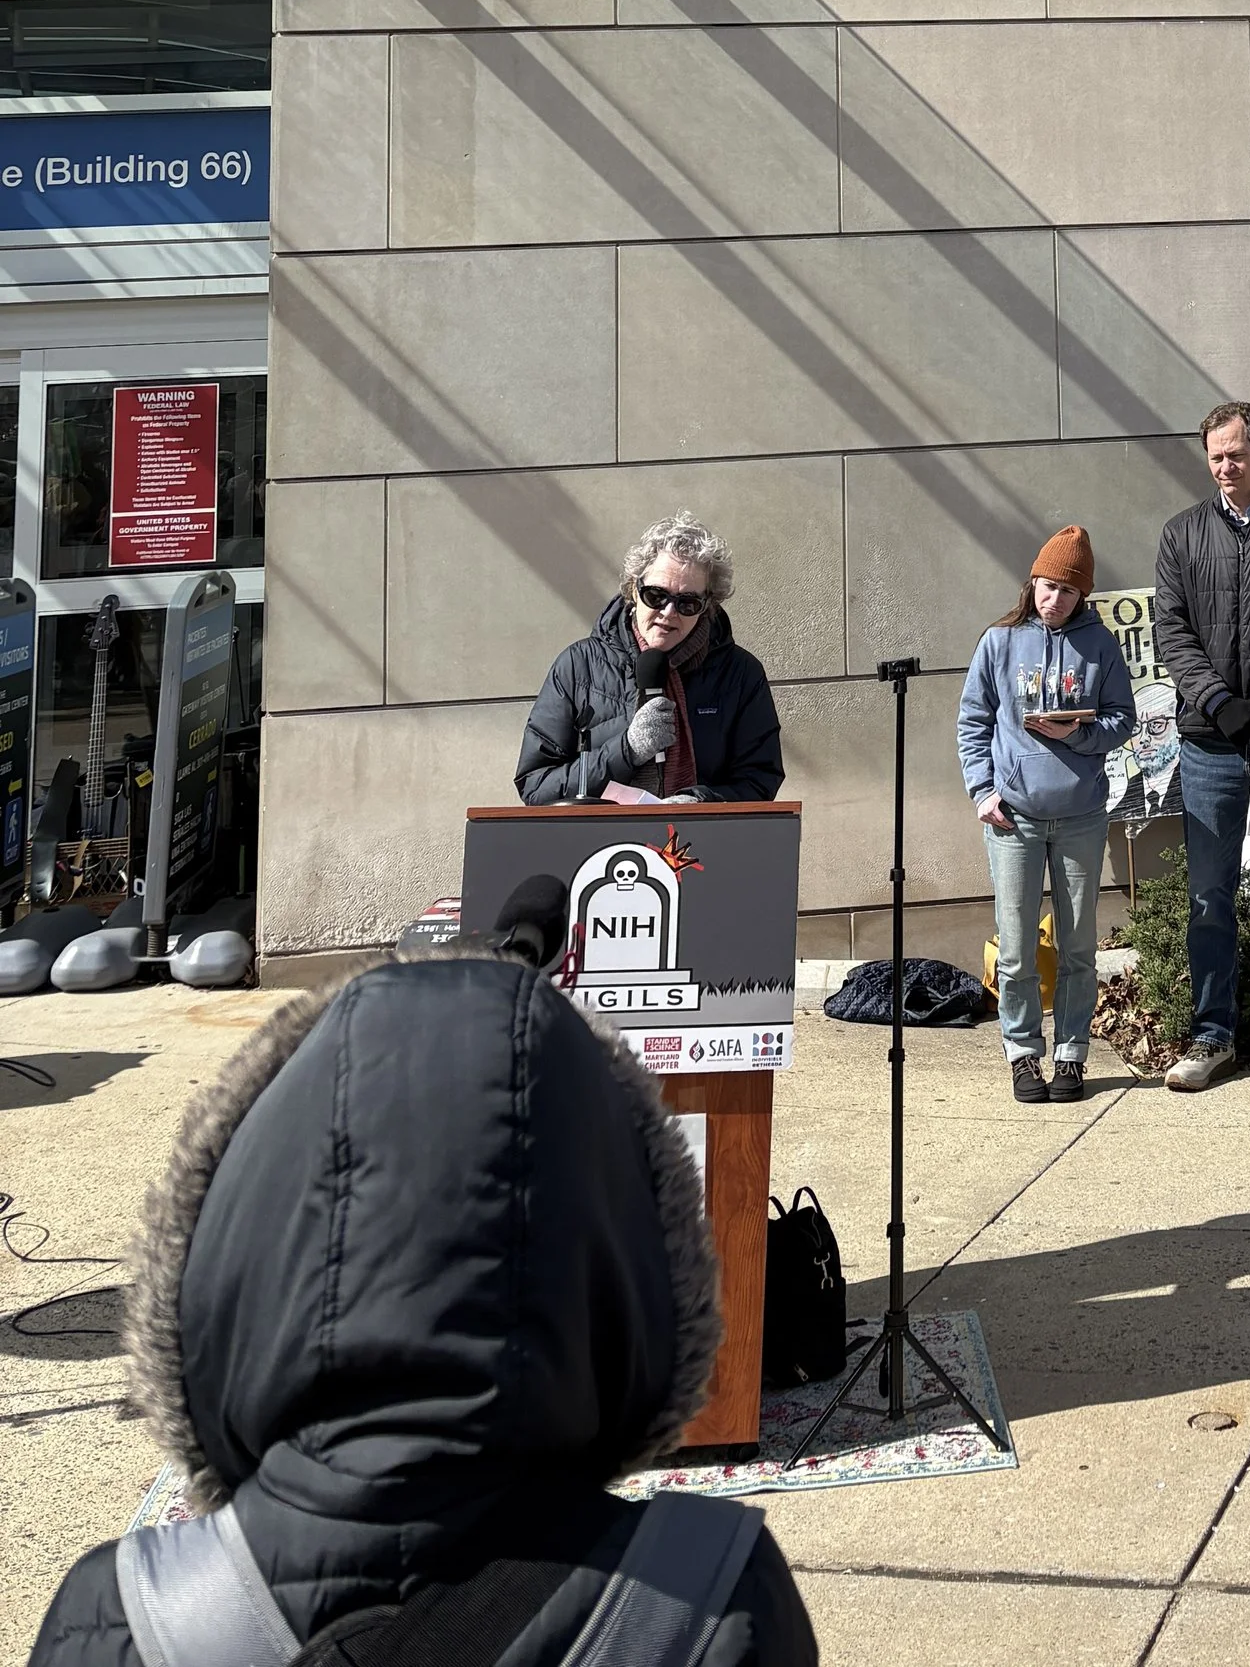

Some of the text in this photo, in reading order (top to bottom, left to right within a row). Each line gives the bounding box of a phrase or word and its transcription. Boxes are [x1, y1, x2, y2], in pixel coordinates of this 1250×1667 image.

[34, 155, 189, 193] (Building
[200, 150, 252, 186] 66)
[137, 391, 195, 402] WARNING
[143, 402, 173, 410] FEDERAL
[136, 516, 191, 525] UNITED STATES
[119, 523, 208, 534] GOVERNMENT PROPERTY
[1086, 596, 1155, 625] TO
[592, 916, 655, 939] NIH
[571, 989, 683, 1008] IGILS
[670, 1037, 680, 1045] UP
[709, 1039, 743, 1057] SAFA
[645, 1054, 680, 1062] MARYLAND
[644, 1062, 679, 1070] CHAPTER
